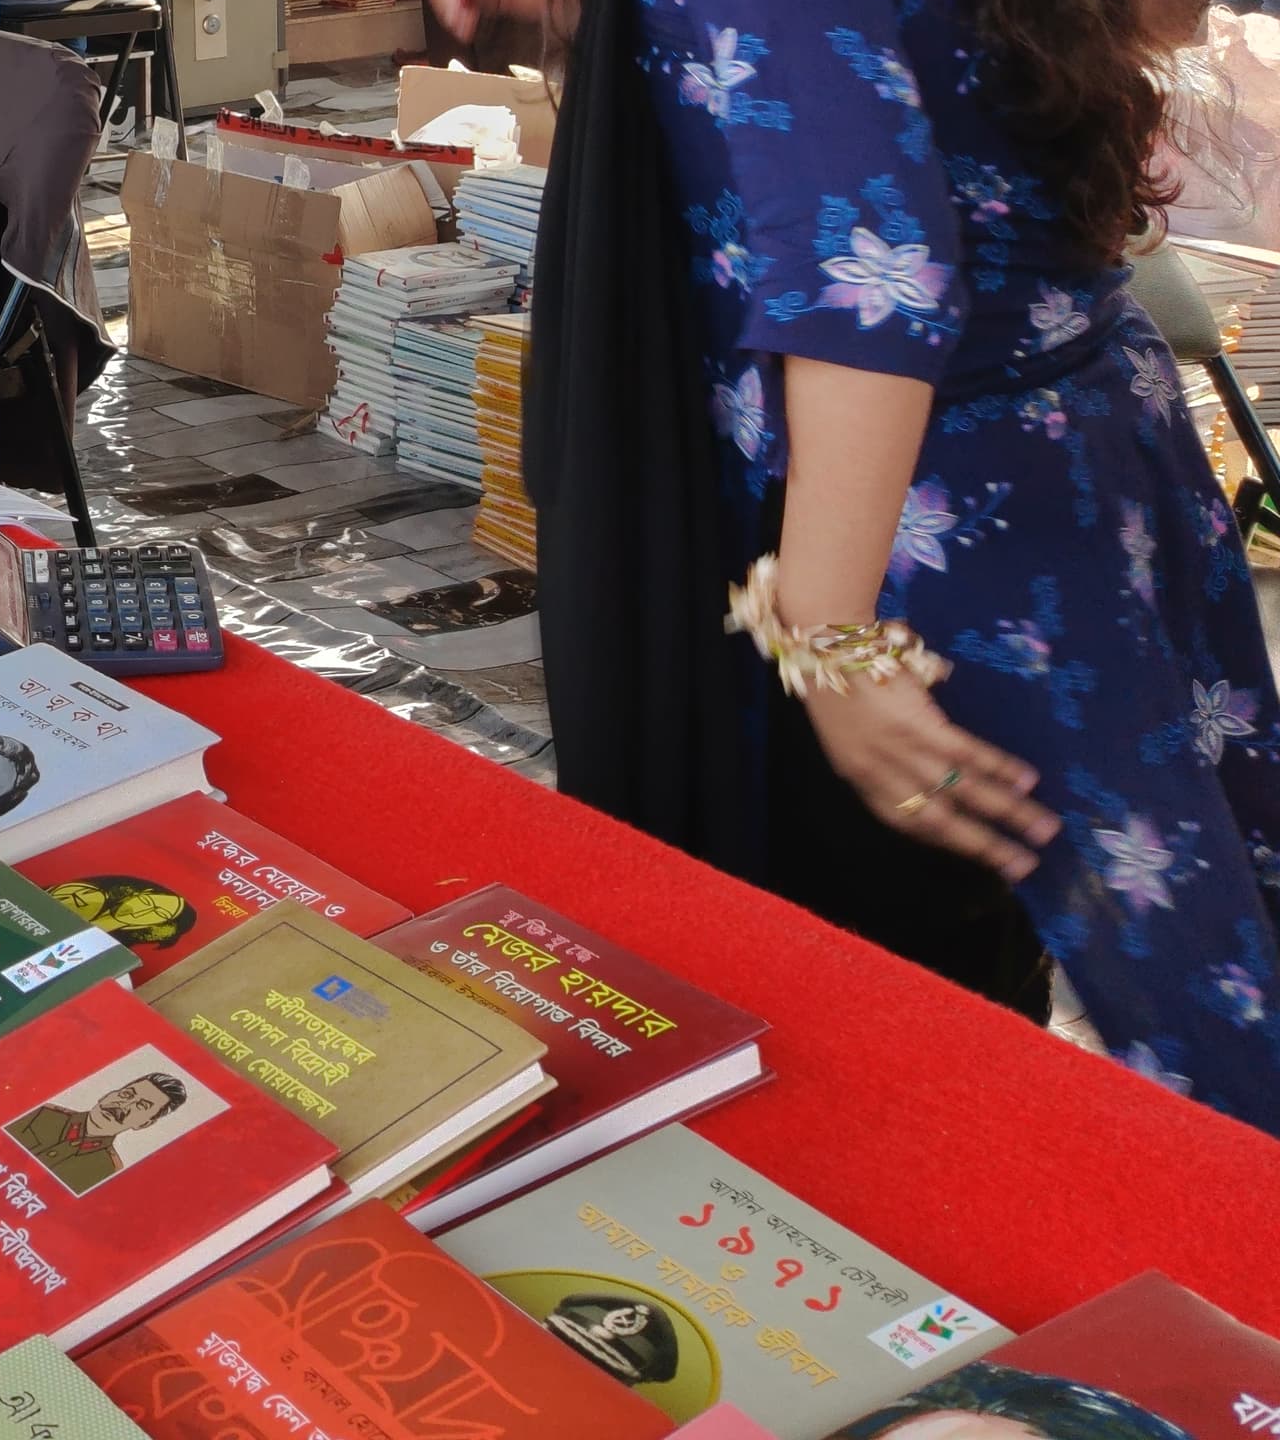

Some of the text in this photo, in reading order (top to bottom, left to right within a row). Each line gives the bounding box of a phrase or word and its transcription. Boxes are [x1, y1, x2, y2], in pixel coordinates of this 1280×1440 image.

[90, 597, 103, 605] 8
[151, 596, 165, 604] 2
[20, 709, 53, 730] মনসুর
[52, 728, 90, 749] আহমদ
[197, 831, 345, 921] যুদ্ধের মেয়েরা ও
[427, 934, 631, 1057] ও তাঁর বিয়োগান্ত বিদায়
[463, 923, 677, 1038] মেজর হায়দার
[184, 1014, 337, 1129] কমান্ডার মোয়াজ্জেম
[230, 1009, 350, 1086] গোপন বিদ্রোহী
[265, 989, 376, 1074] স্বাধীনতাযুদ্ধের
[709, 1178, 764, 1215] আমীন
[840, 1266, 909, 1307] চৌধুরী
[570, 1197, 837, 1386] আমার সামরিক জীবন
[197, 1332, 270, 1394] মুক্তিযুদ্ধ
[257, 1386, 308, 1436] কেন
